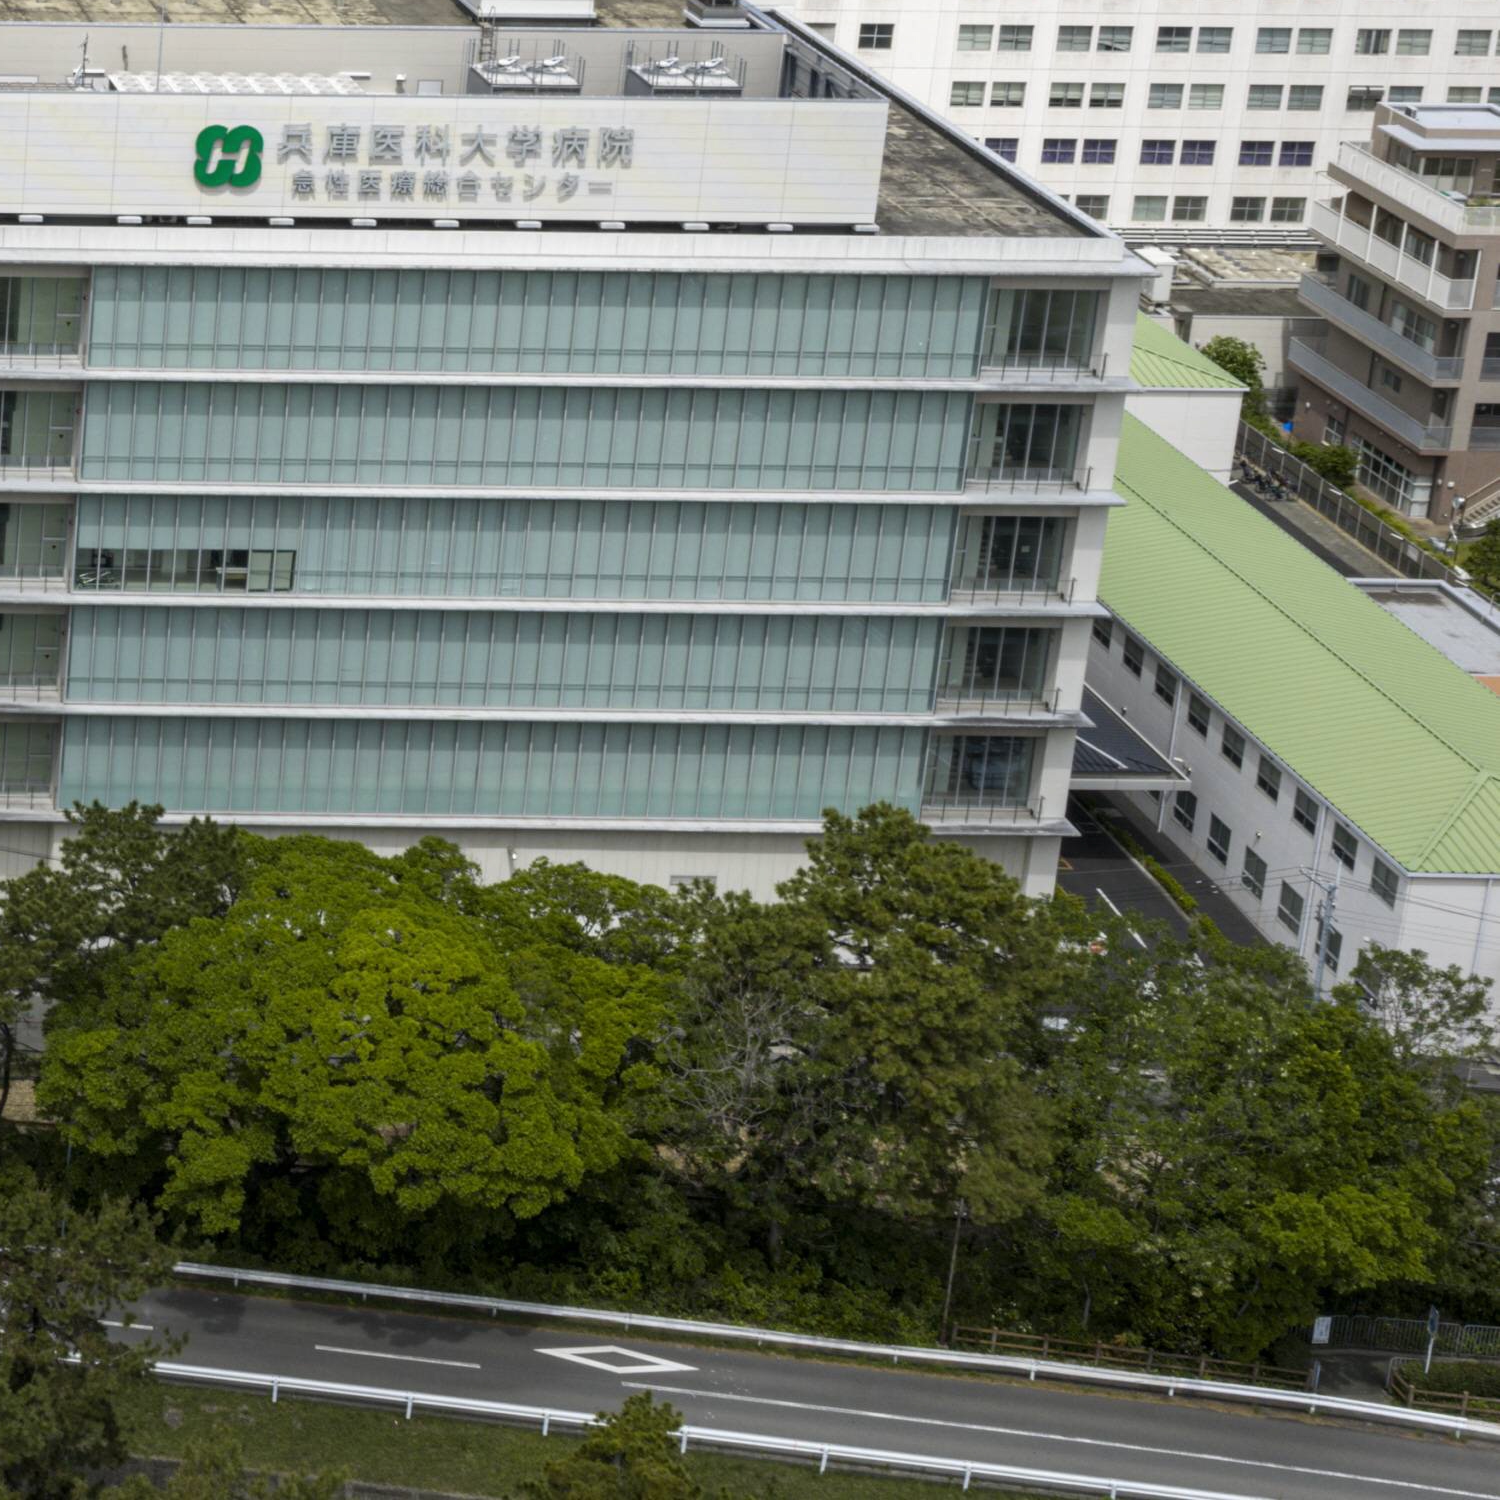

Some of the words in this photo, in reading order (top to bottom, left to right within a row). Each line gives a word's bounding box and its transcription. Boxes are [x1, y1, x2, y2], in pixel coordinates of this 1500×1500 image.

[278, 123, 634, 165] 兵庫医科大学病院
[293, 169, 613, 199] 急性医療総合センター
